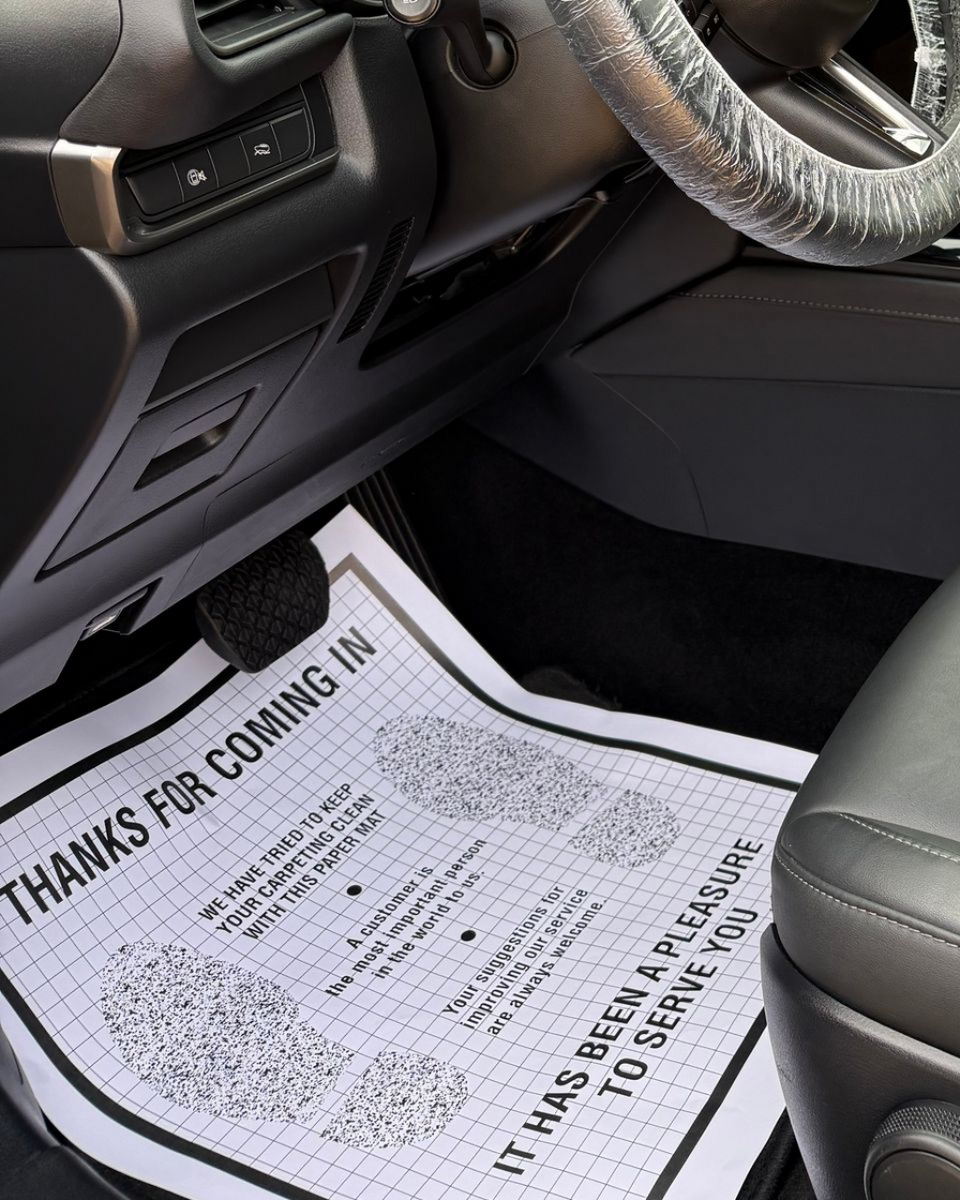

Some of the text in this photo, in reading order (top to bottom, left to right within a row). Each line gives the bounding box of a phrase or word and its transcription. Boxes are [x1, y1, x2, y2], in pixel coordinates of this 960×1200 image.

[0, 626, 378, 925] THANKS FOR COMING IN
[198, 783, 353, 921] WE HAVE TRIED TO KEEP
[216, 793, 375, 934] YOUR CARPETING CLEAN
[242, 809, 386, 940] WITH THIS PAPER MAT
[325, 839, 487, 997] the most important person
[346, 867, 434, 949] A customer is
[371, 871, 485, 979] in the world to us.
[442, 886, 564, 1015] Your suggestions for
[460, 889, 588, 1030] improving our service
[487, 899, 607, 1035] are always welcome.
[493, 838, 764, 1175] IT HAS BEEN A PLEASURE
[597, 906, 758, 1098] TO SERVE YOU
